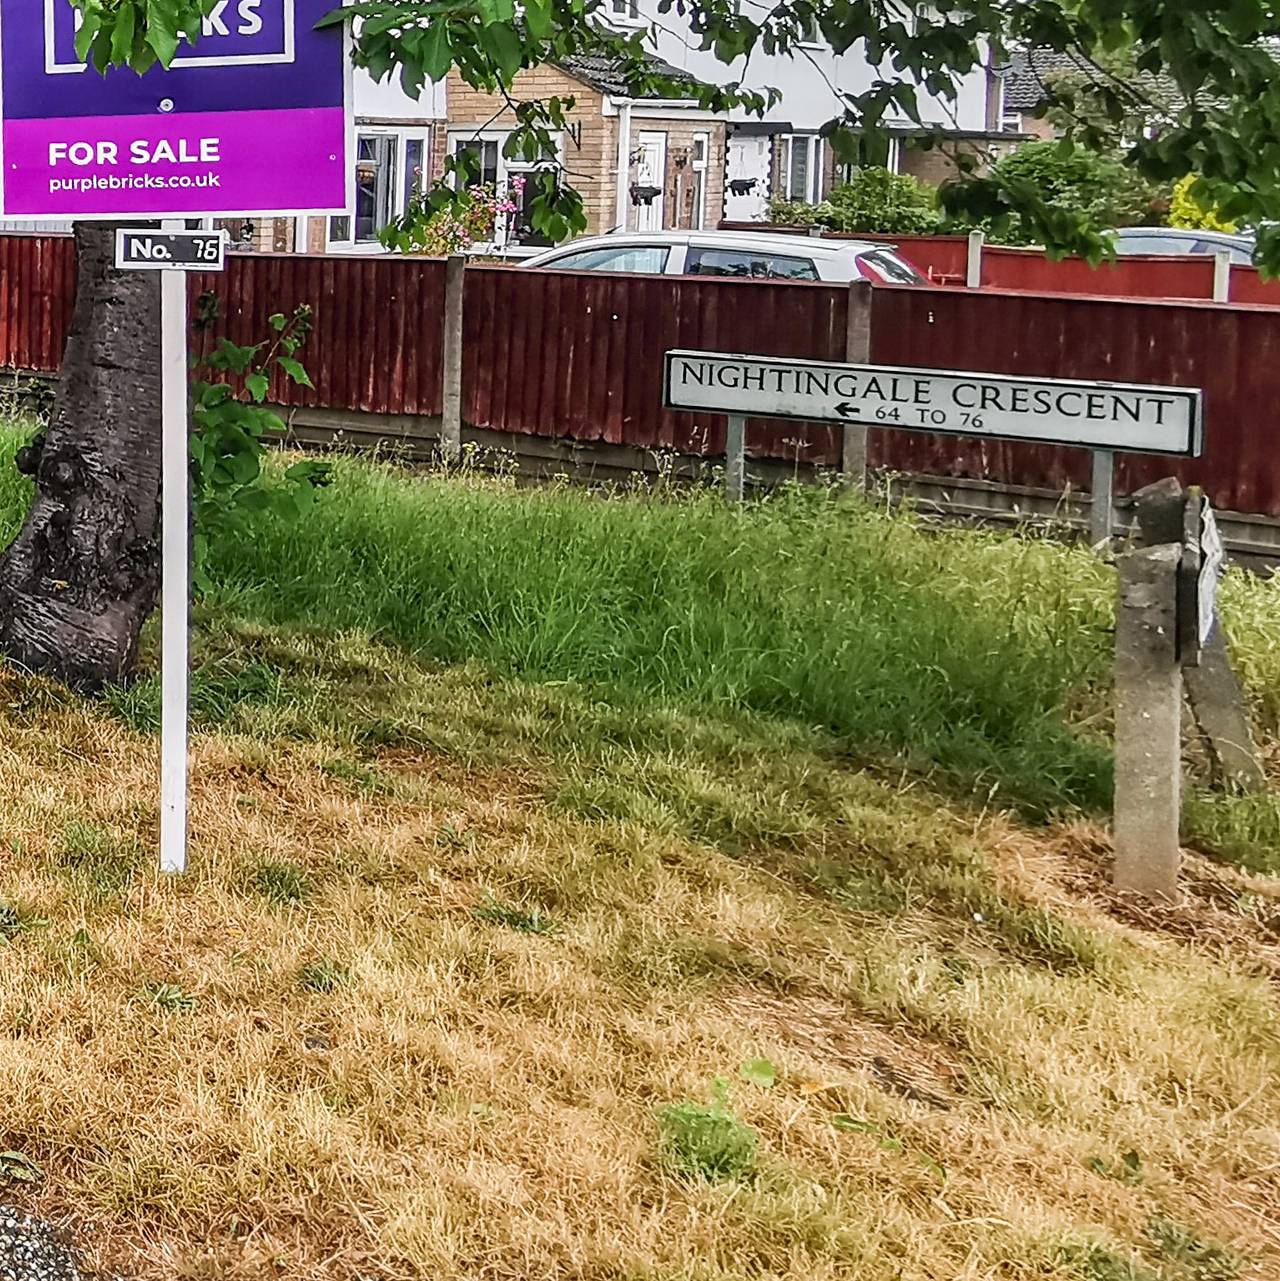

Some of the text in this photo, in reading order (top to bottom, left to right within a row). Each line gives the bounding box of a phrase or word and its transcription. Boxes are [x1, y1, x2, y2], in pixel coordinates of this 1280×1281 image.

[48, 138, 220, 166] FOR SALE
[49, 172, 220, 193] purplebricks.co.uk
[130, 238, 218, 260] No. 76
[681, 361, 1175, 425] NIGHTINGALE CRESCENT
[875, 406, 984, 429] 64 TO 76
